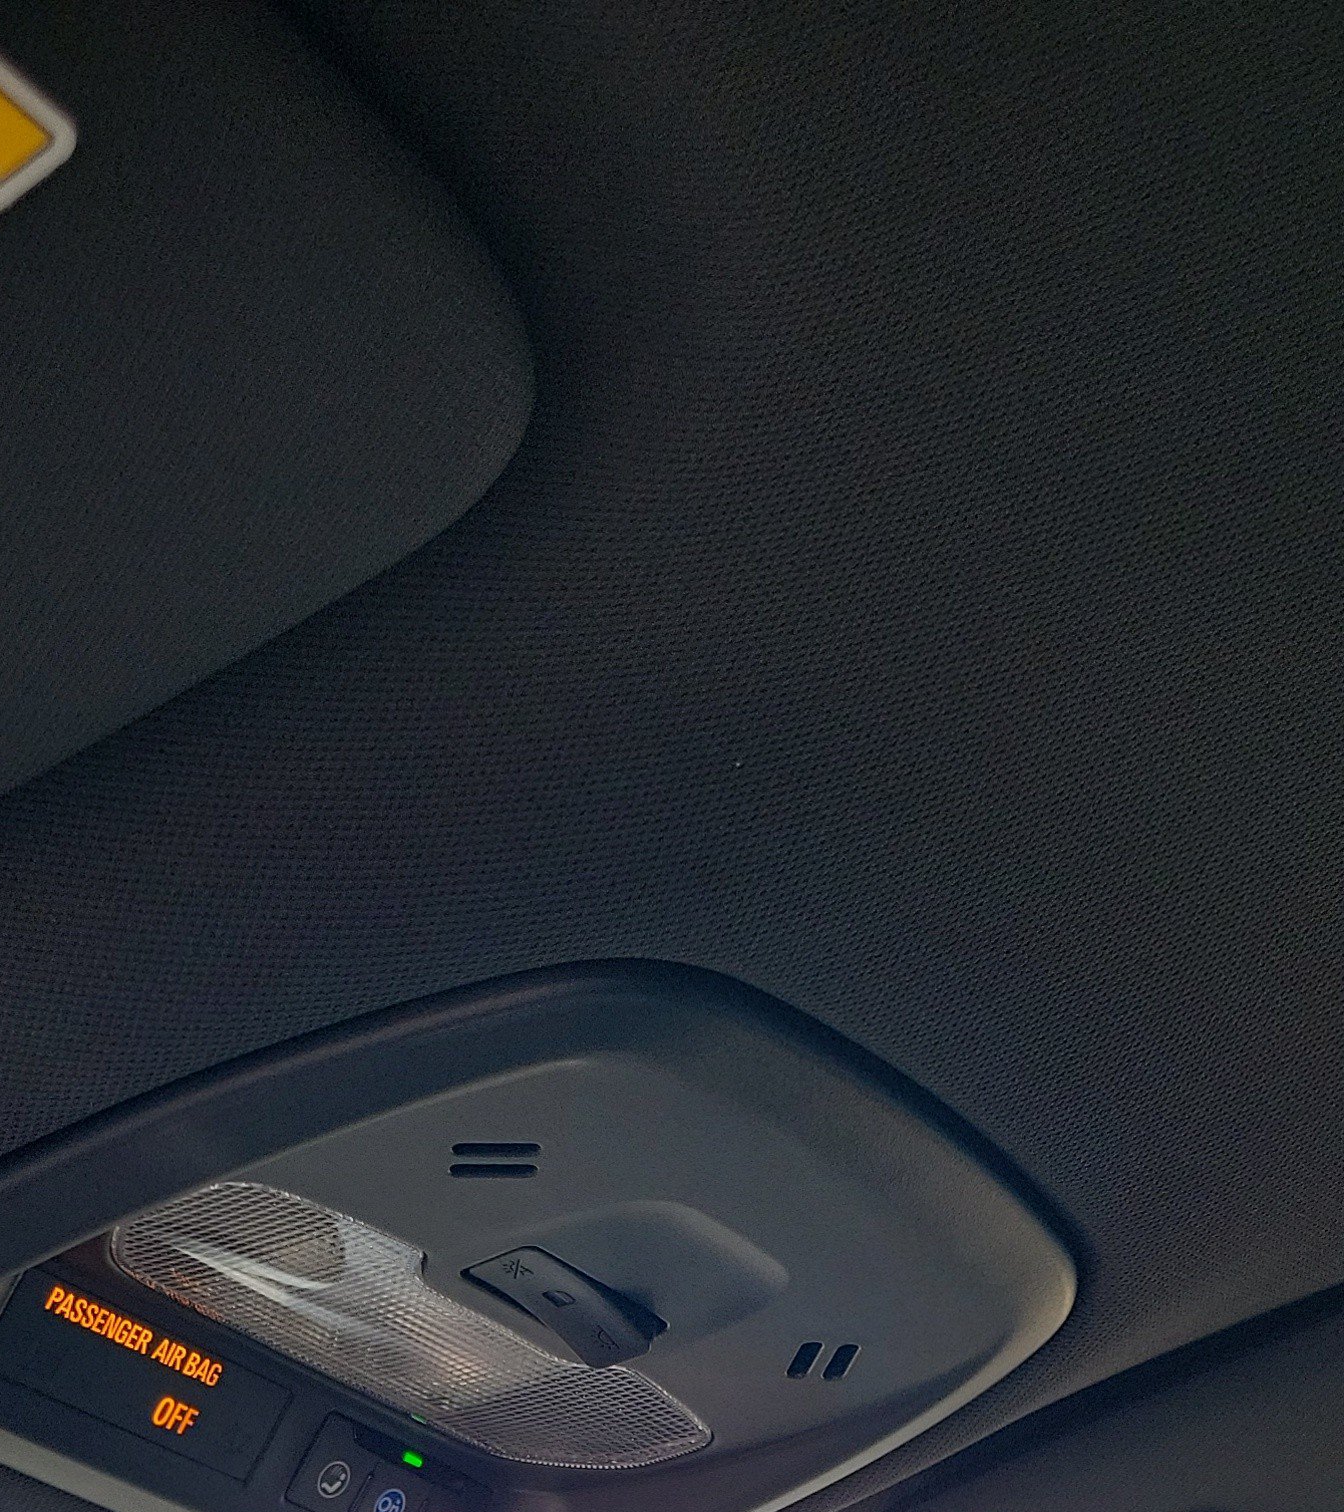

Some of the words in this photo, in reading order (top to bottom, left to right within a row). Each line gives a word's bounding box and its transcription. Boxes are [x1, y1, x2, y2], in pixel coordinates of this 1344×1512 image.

[44, 1286, 154, 1355] PASSENGER
[150, 1337, 187, 1371] AIR
[182, 1351, 223, 1387] BAG
[152, 1396, 200, 1435] OFF
